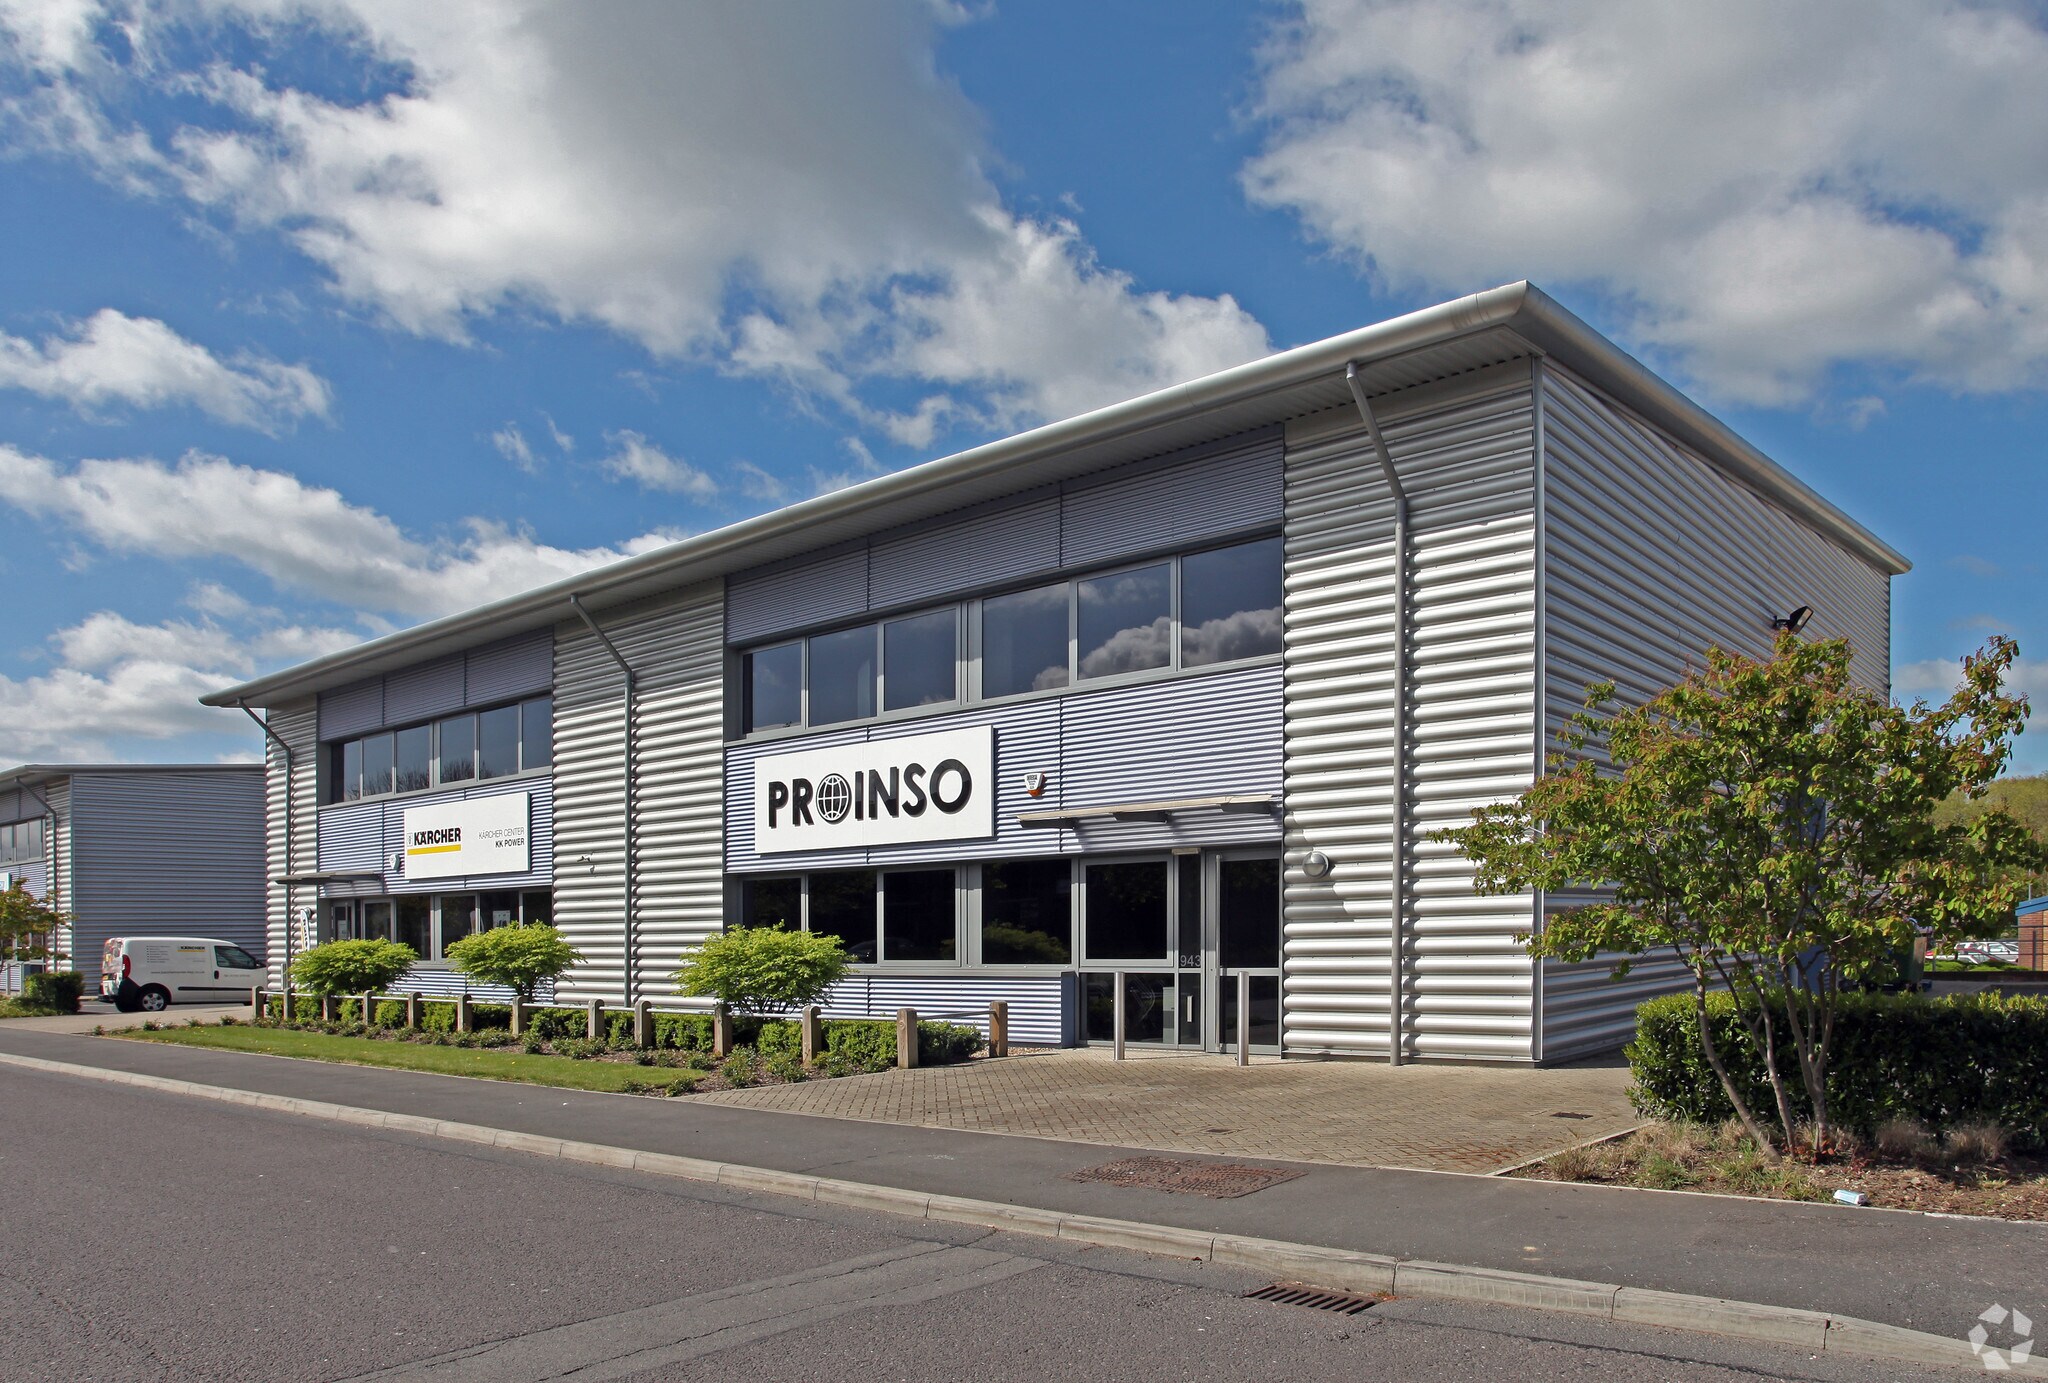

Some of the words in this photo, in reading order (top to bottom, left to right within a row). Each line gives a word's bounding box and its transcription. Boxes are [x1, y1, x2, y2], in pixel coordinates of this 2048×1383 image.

[768, 758, 973, 829] PROINSO
[413, 828, 461, 846] KÄRCHER
[504, 827, 524, 837] CENTER
[495, 840, 503, 848] KK
[504, 837, 524, 847] POWER
[1180, 954, 1201, 967] 943
